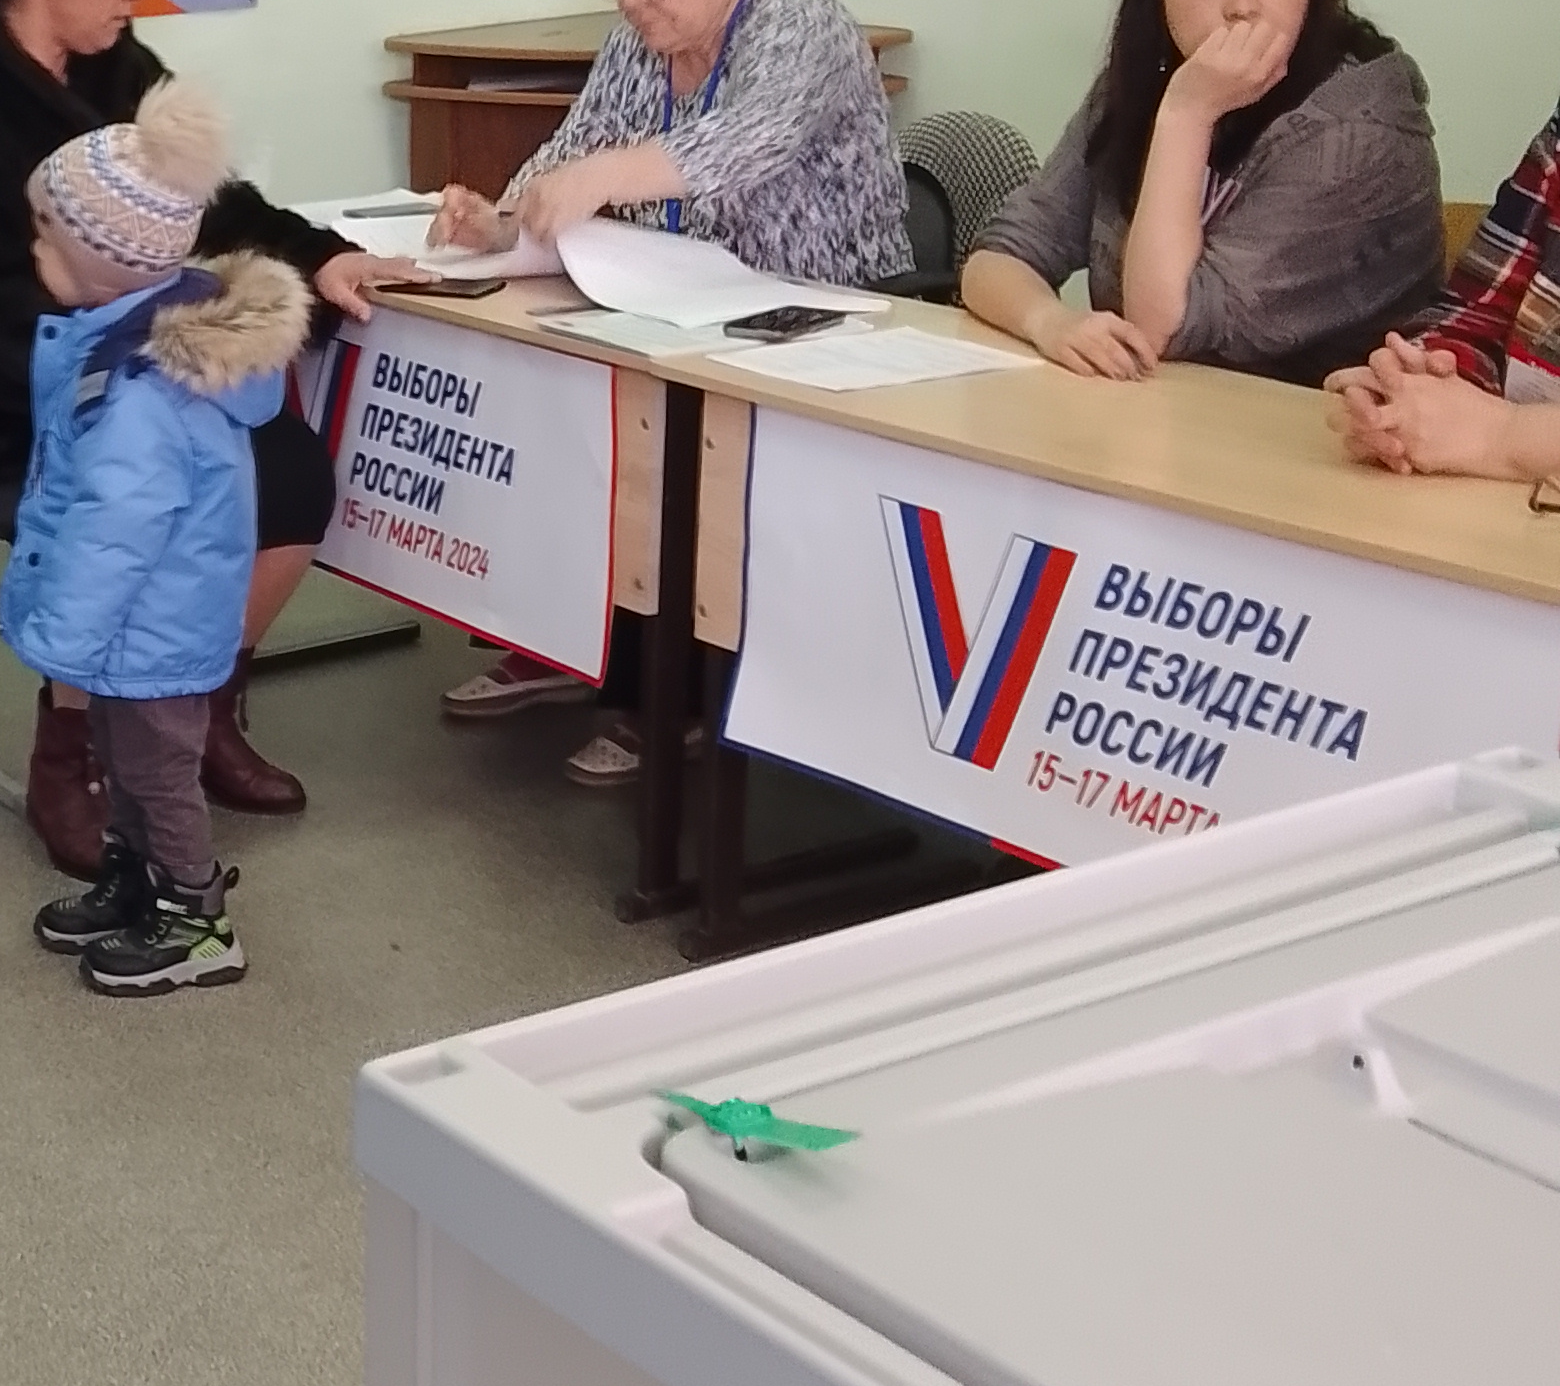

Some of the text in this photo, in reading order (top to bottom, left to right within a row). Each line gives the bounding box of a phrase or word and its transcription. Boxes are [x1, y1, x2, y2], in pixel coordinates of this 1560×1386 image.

[371, 352, 482, 418] ВЫБОРЫ
[349, 451, 445, 516] РОССИИ
[360, 403, 515, 486] ПРЕЗИДЕНТА
[386, 514, 445, 564] МАРТА
[446, 537, 490, 581] 2024
[1094, 563, 1312, 663] ВЫБОРЫ
[1068, 628, 1368, 762] ПРЕЗИДЕНТА
[1044, 691, 1229, 788] РОССИИ
